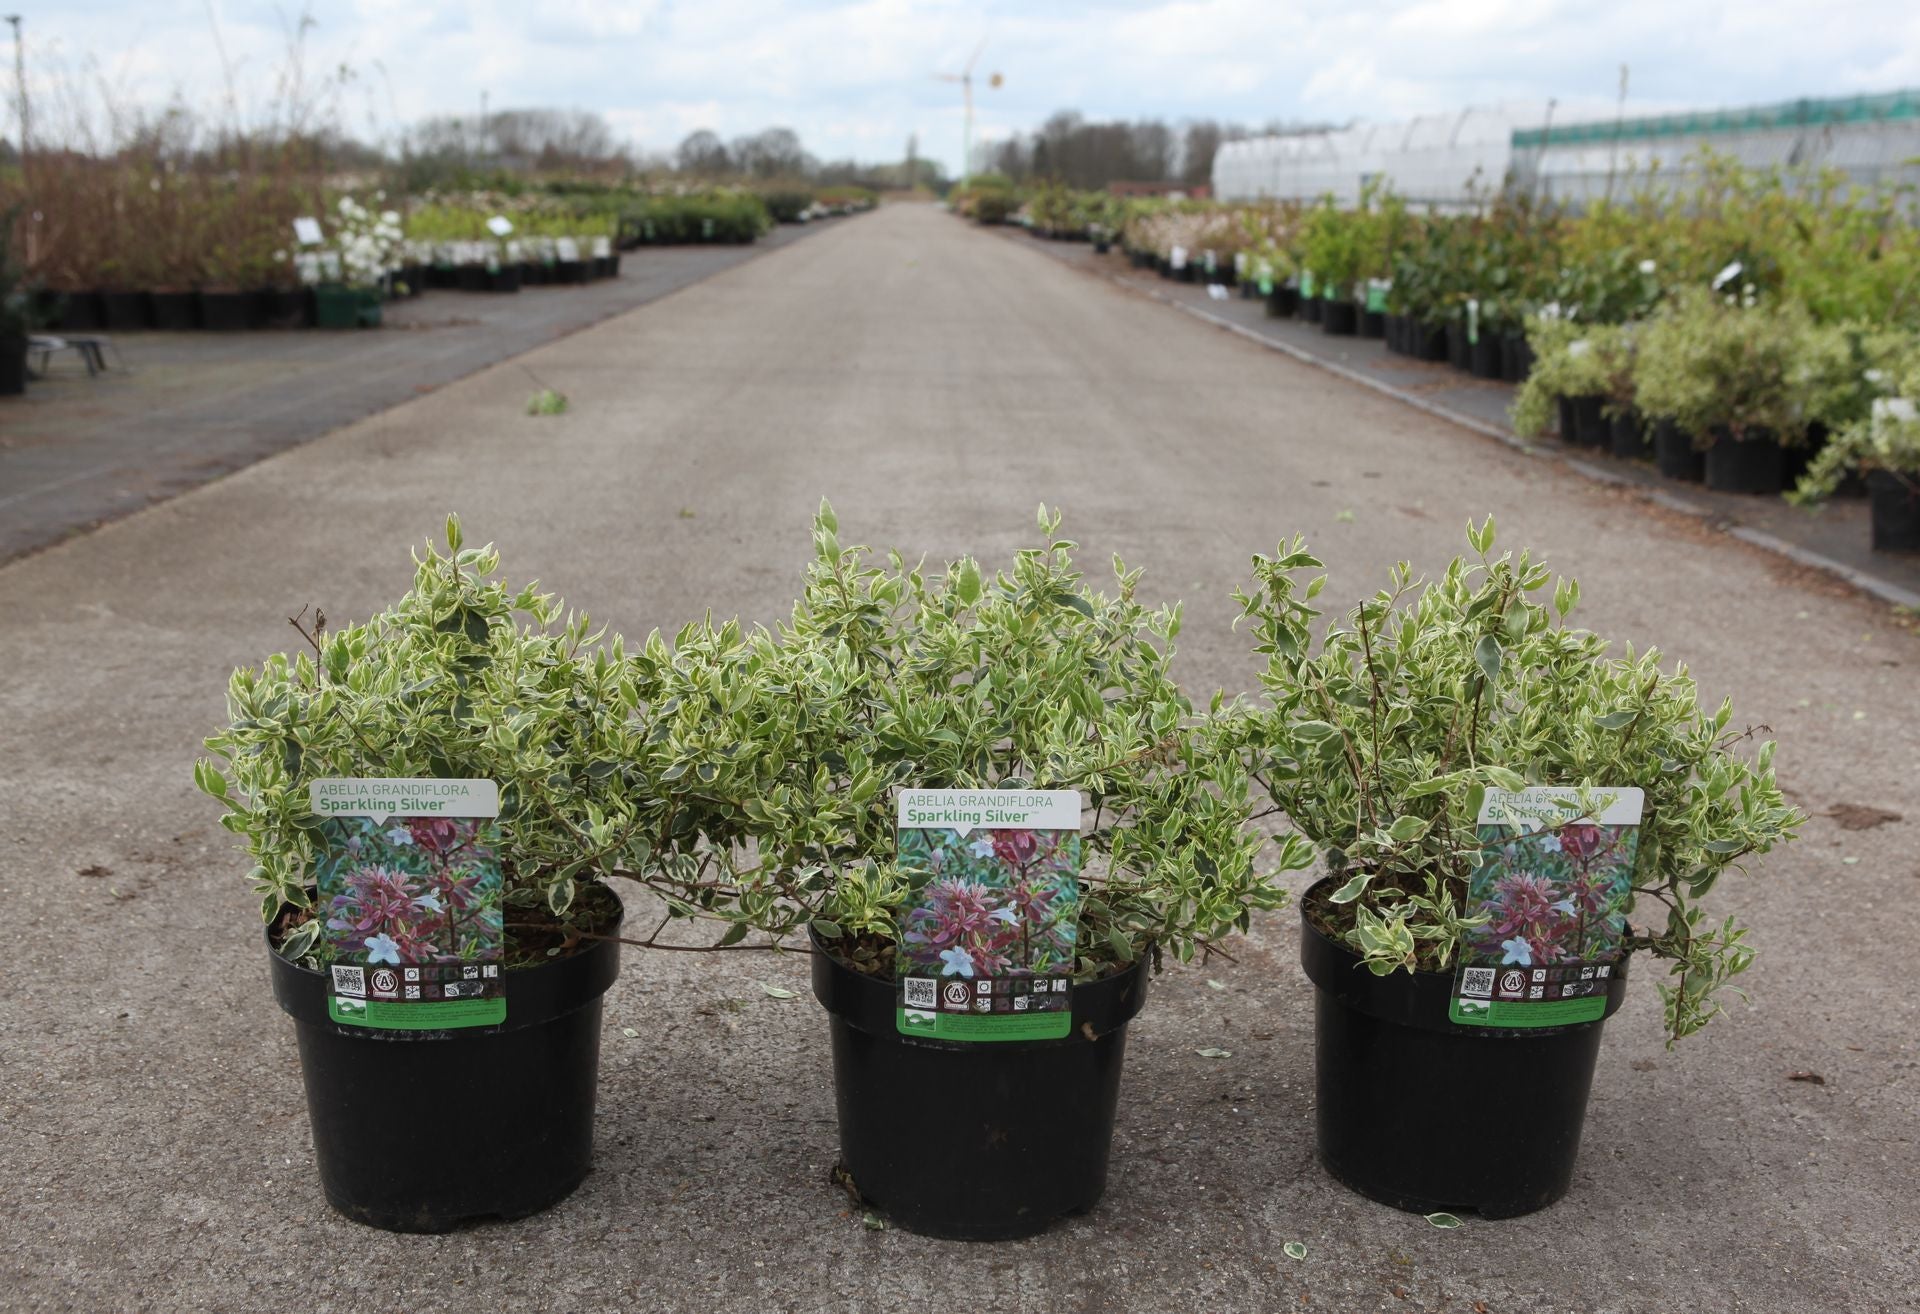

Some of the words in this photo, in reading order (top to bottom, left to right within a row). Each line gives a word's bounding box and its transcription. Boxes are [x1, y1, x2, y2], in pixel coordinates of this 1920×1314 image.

[319, 784, 368, 796] ABELIA
[372, 784, 470, 796] GRANDIFLORA
[320, 798, 396, 813] Sparkling
[400, 798, 446, 811] Silver
[907, 795, 955, 807] ABELIA
[959, 795, 1053, 808] GRANDIFLORA
[907, 809, 981, 825] Sparkling
[985, 809, 1029, 823] Silver
